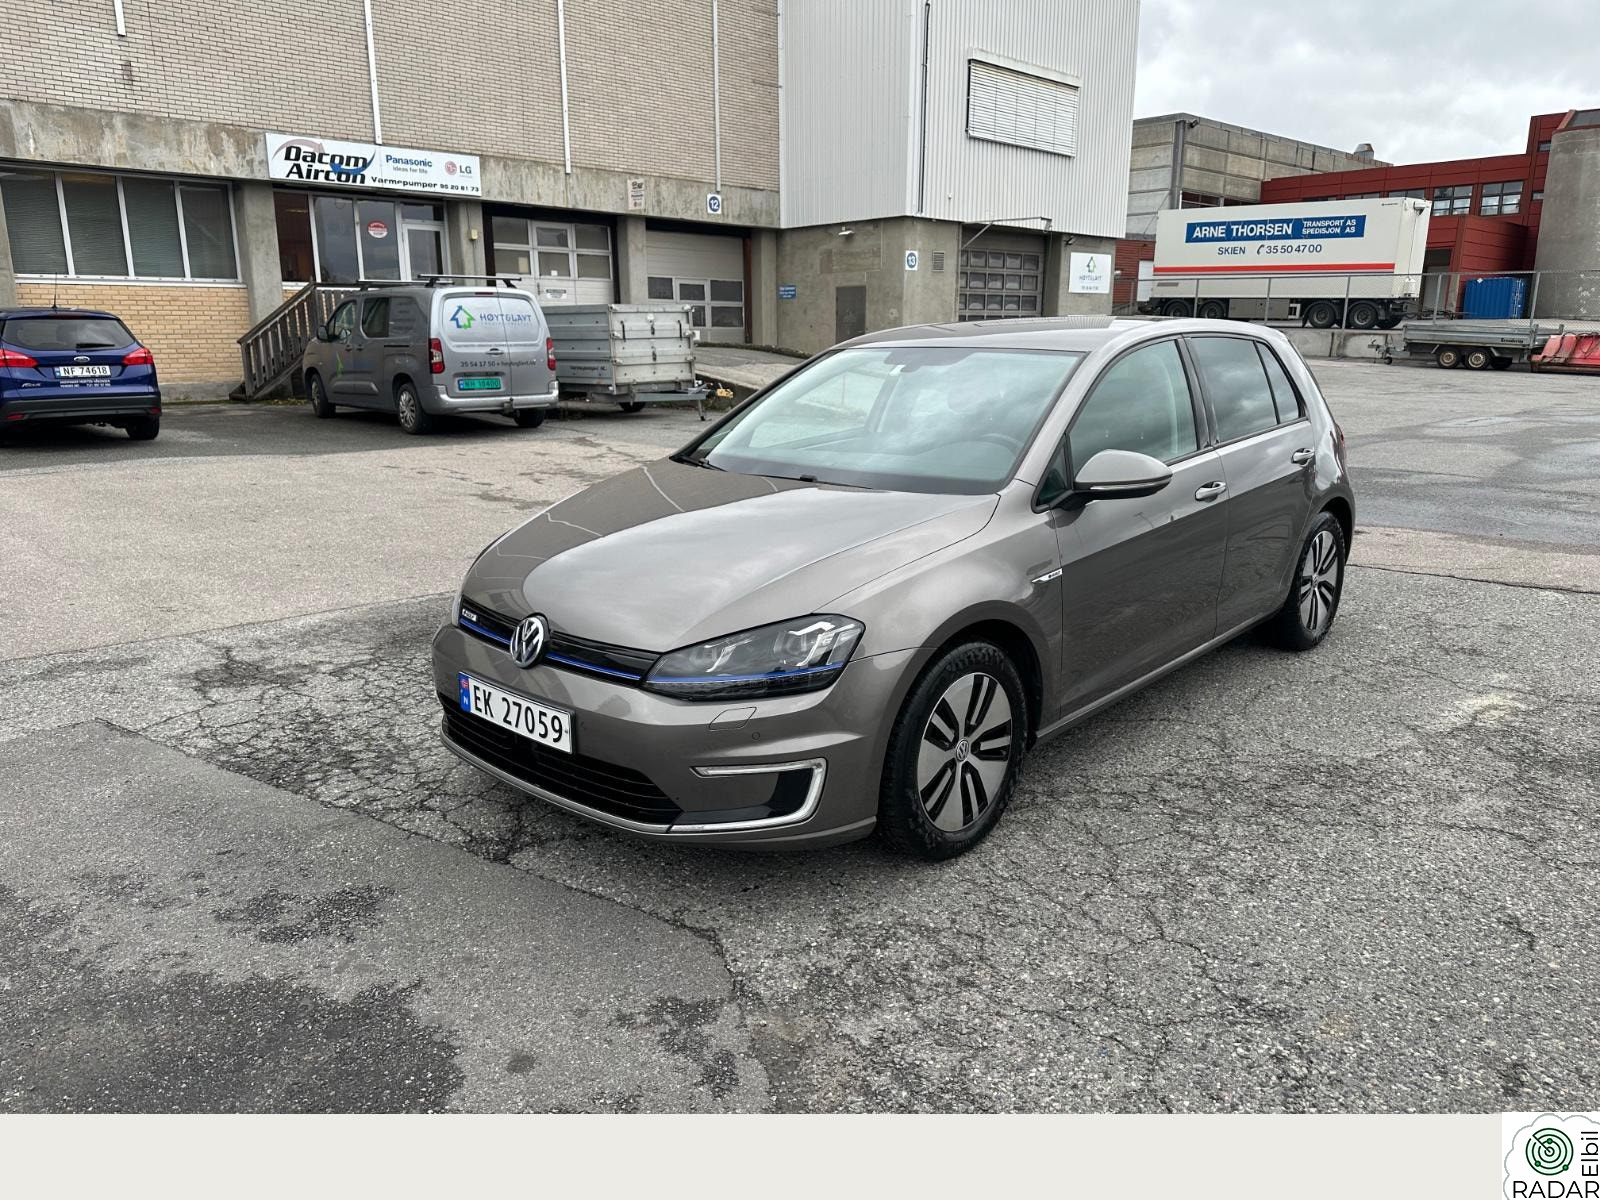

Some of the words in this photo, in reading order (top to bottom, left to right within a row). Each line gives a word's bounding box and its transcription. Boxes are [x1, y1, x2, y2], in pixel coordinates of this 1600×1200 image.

[284, 145, 368, 169] Dacom
[385, 154, 433, 168] Panasonic
[286, 162, 366, 185] Aircon
[459, 165, 472, 174] LG
[710, 199, 719, 210] 12
[1302, 219, 1344, 228] TRANSPORT
[1192, 225, 1226, 239] ARNE
[1231, 223, 1293, 237] THORSEN
[1301, 227, 1341, 235] SPEDISJON
[1217, 246, 1246, 256] SKIEN
[1265, 245, 1278, 255] 35
[1279, 245, 1293, 254] 50
[907, 255, 916, 266] 13
[63, 367, 76, 375] NF
[80, 366, 108, 375] 74618
[472, 684, 494, 718] EK
[501, 697, 563, 743] 27059
